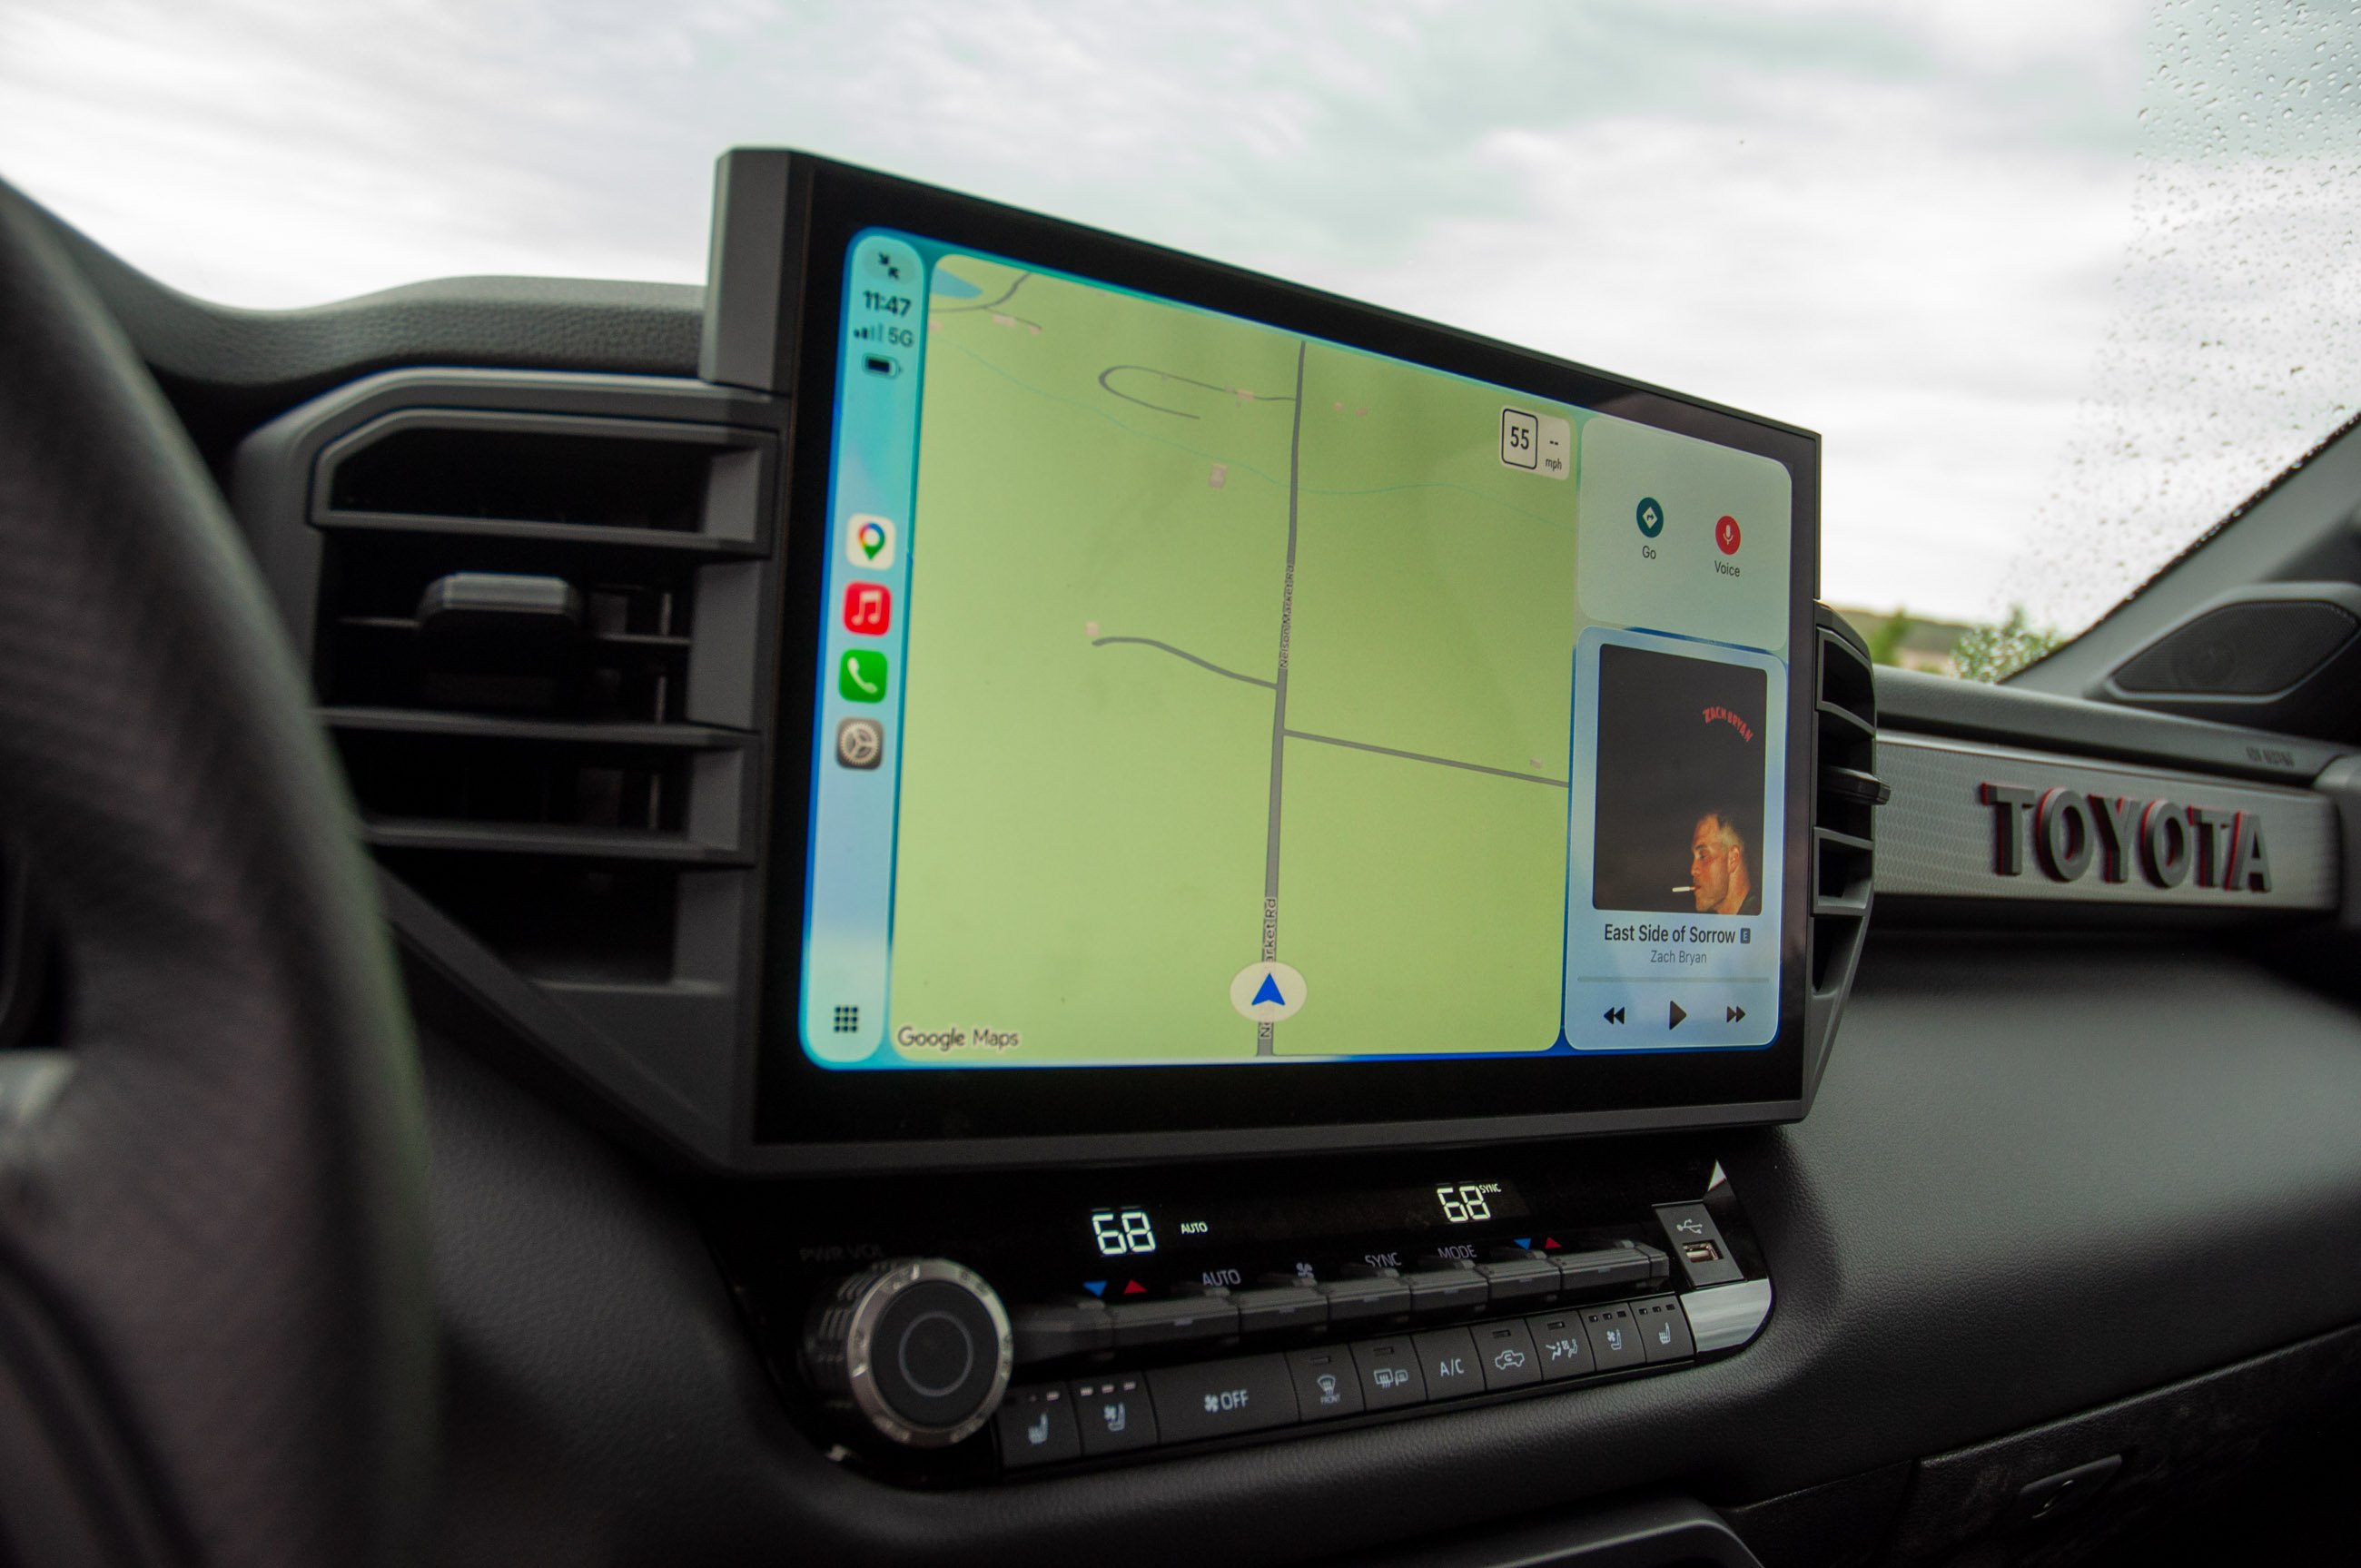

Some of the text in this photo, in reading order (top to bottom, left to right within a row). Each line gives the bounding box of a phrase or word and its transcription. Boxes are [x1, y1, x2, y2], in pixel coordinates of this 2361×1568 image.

[863, 290, 912, 317] 11:47
[888, 326, 914, 348] 5G
[1510, 426, 1529, 450] 55
[1545, 458, 1562, 471] mph
[1642, 545, 1656, 559] Go
[1714, 560, 1740, 577] Voice
[1279, 565, 1295, 668] Nelson Market Rd
[1727, 711, 1753, 743] BRYAN
[1981, 782, 2272, 892] TOYOTA
[1264, 898, 1277, 962] arket Rd
[1605, 923, 1635, 942] East
[1638, 924, 1669, 942] Side
[1672, 925, 1686, 942] of
[1689, 926, 1736, 943] Sorrow
[1650, 950, 1707, 966] Zach Bryan
[898, 1026, 1020, 1052] Google Maps
[1437, 1183, 1502, 1221] 68 SYNC
[1092, 1212, 1156, 1255] 68
[1180, 1221, 1209, 1235] AUTO
[1365, 1252, 1402, 1267] SYNC
[1437, 1244, 1477, 1260] MODE
[1202, 1268, 1241, 1287] AUTO
[1440, 1358, 1465, 1377] A/C
[1220, 1389, 1250, 1411] OFF
[1319, 1393, 1341, 1405] FRONT
